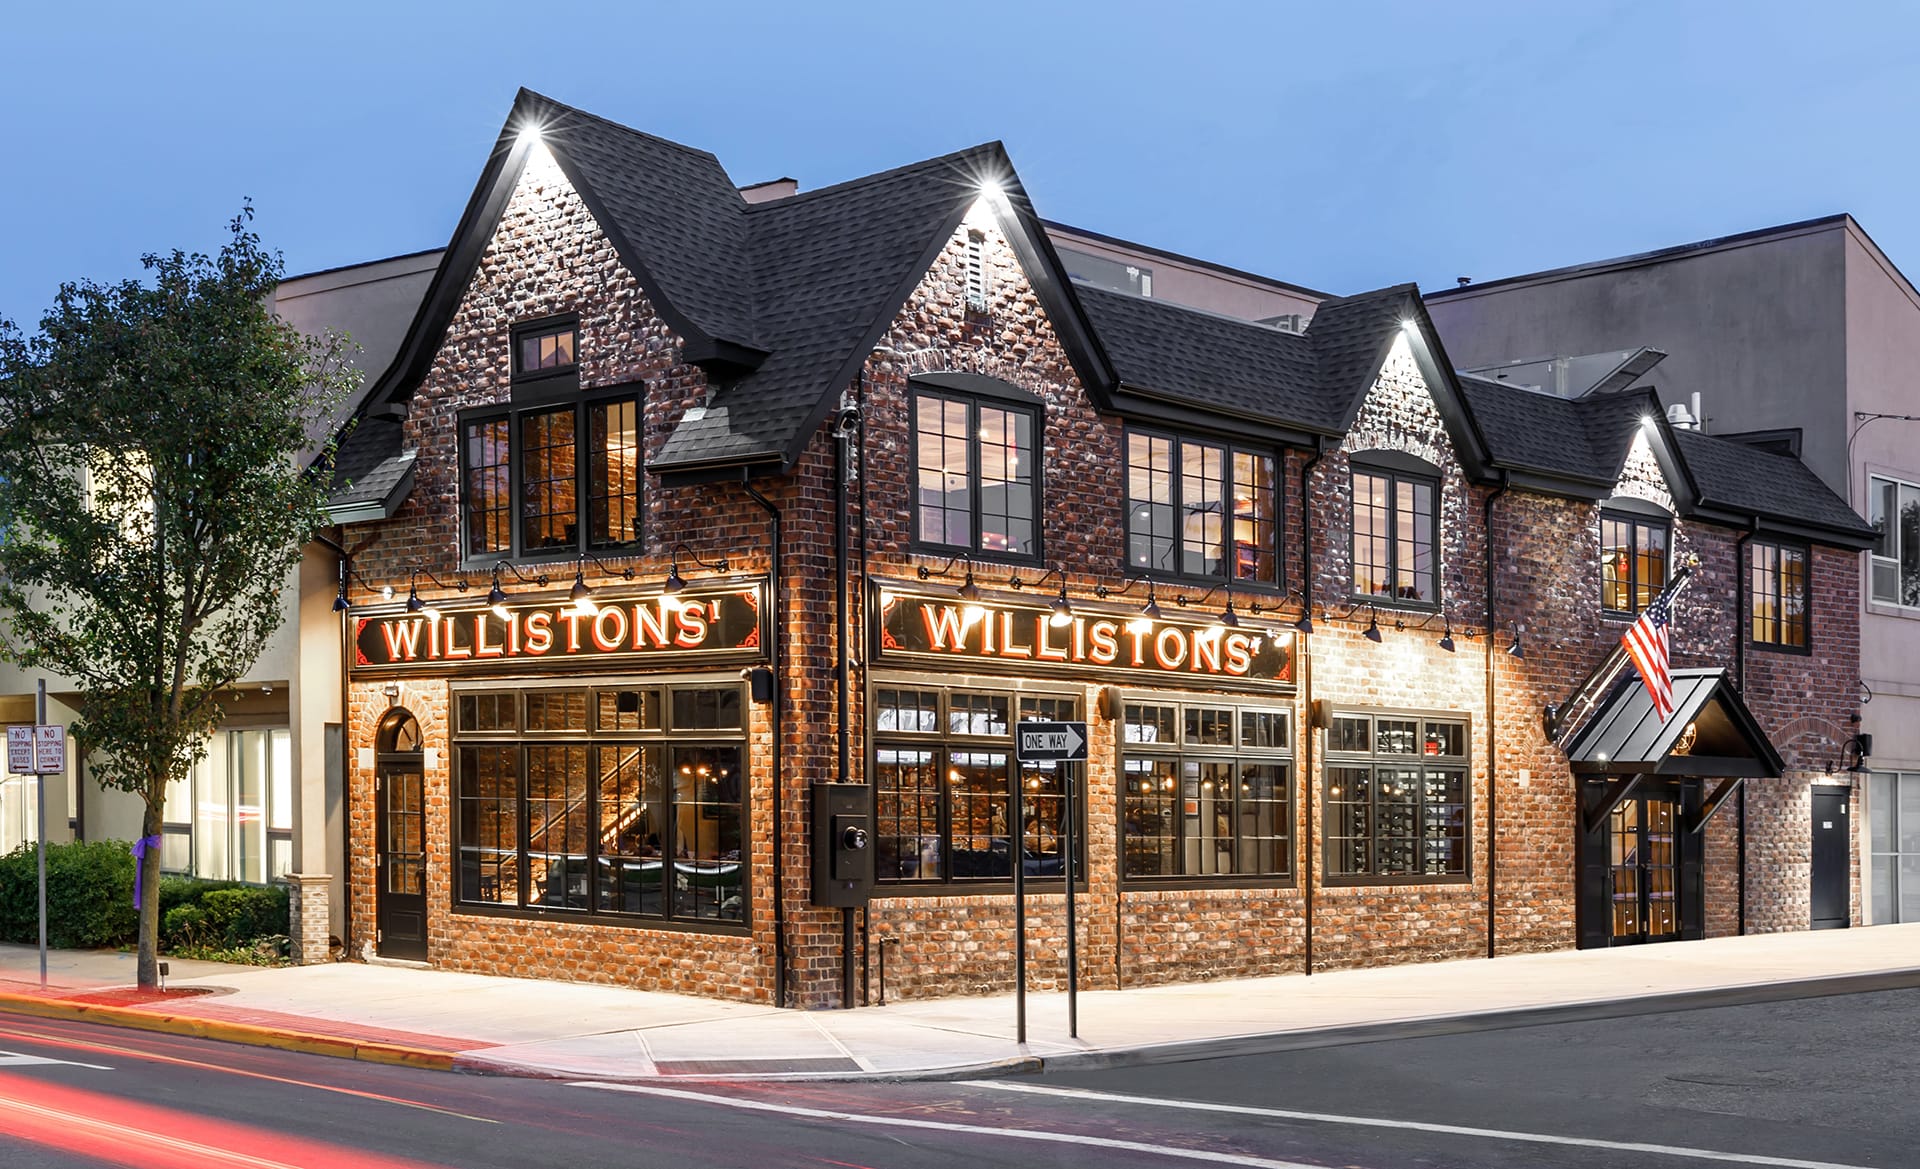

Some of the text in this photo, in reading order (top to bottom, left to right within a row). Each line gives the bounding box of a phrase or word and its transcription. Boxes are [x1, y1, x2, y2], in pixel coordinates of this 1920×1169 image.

[15, 730, 26, 739] NO
[44, 729, 55, 739] NO
[1025, 734, 1067, 749] ONE WAY
[10, 748, 30, 756] EXCEPT
